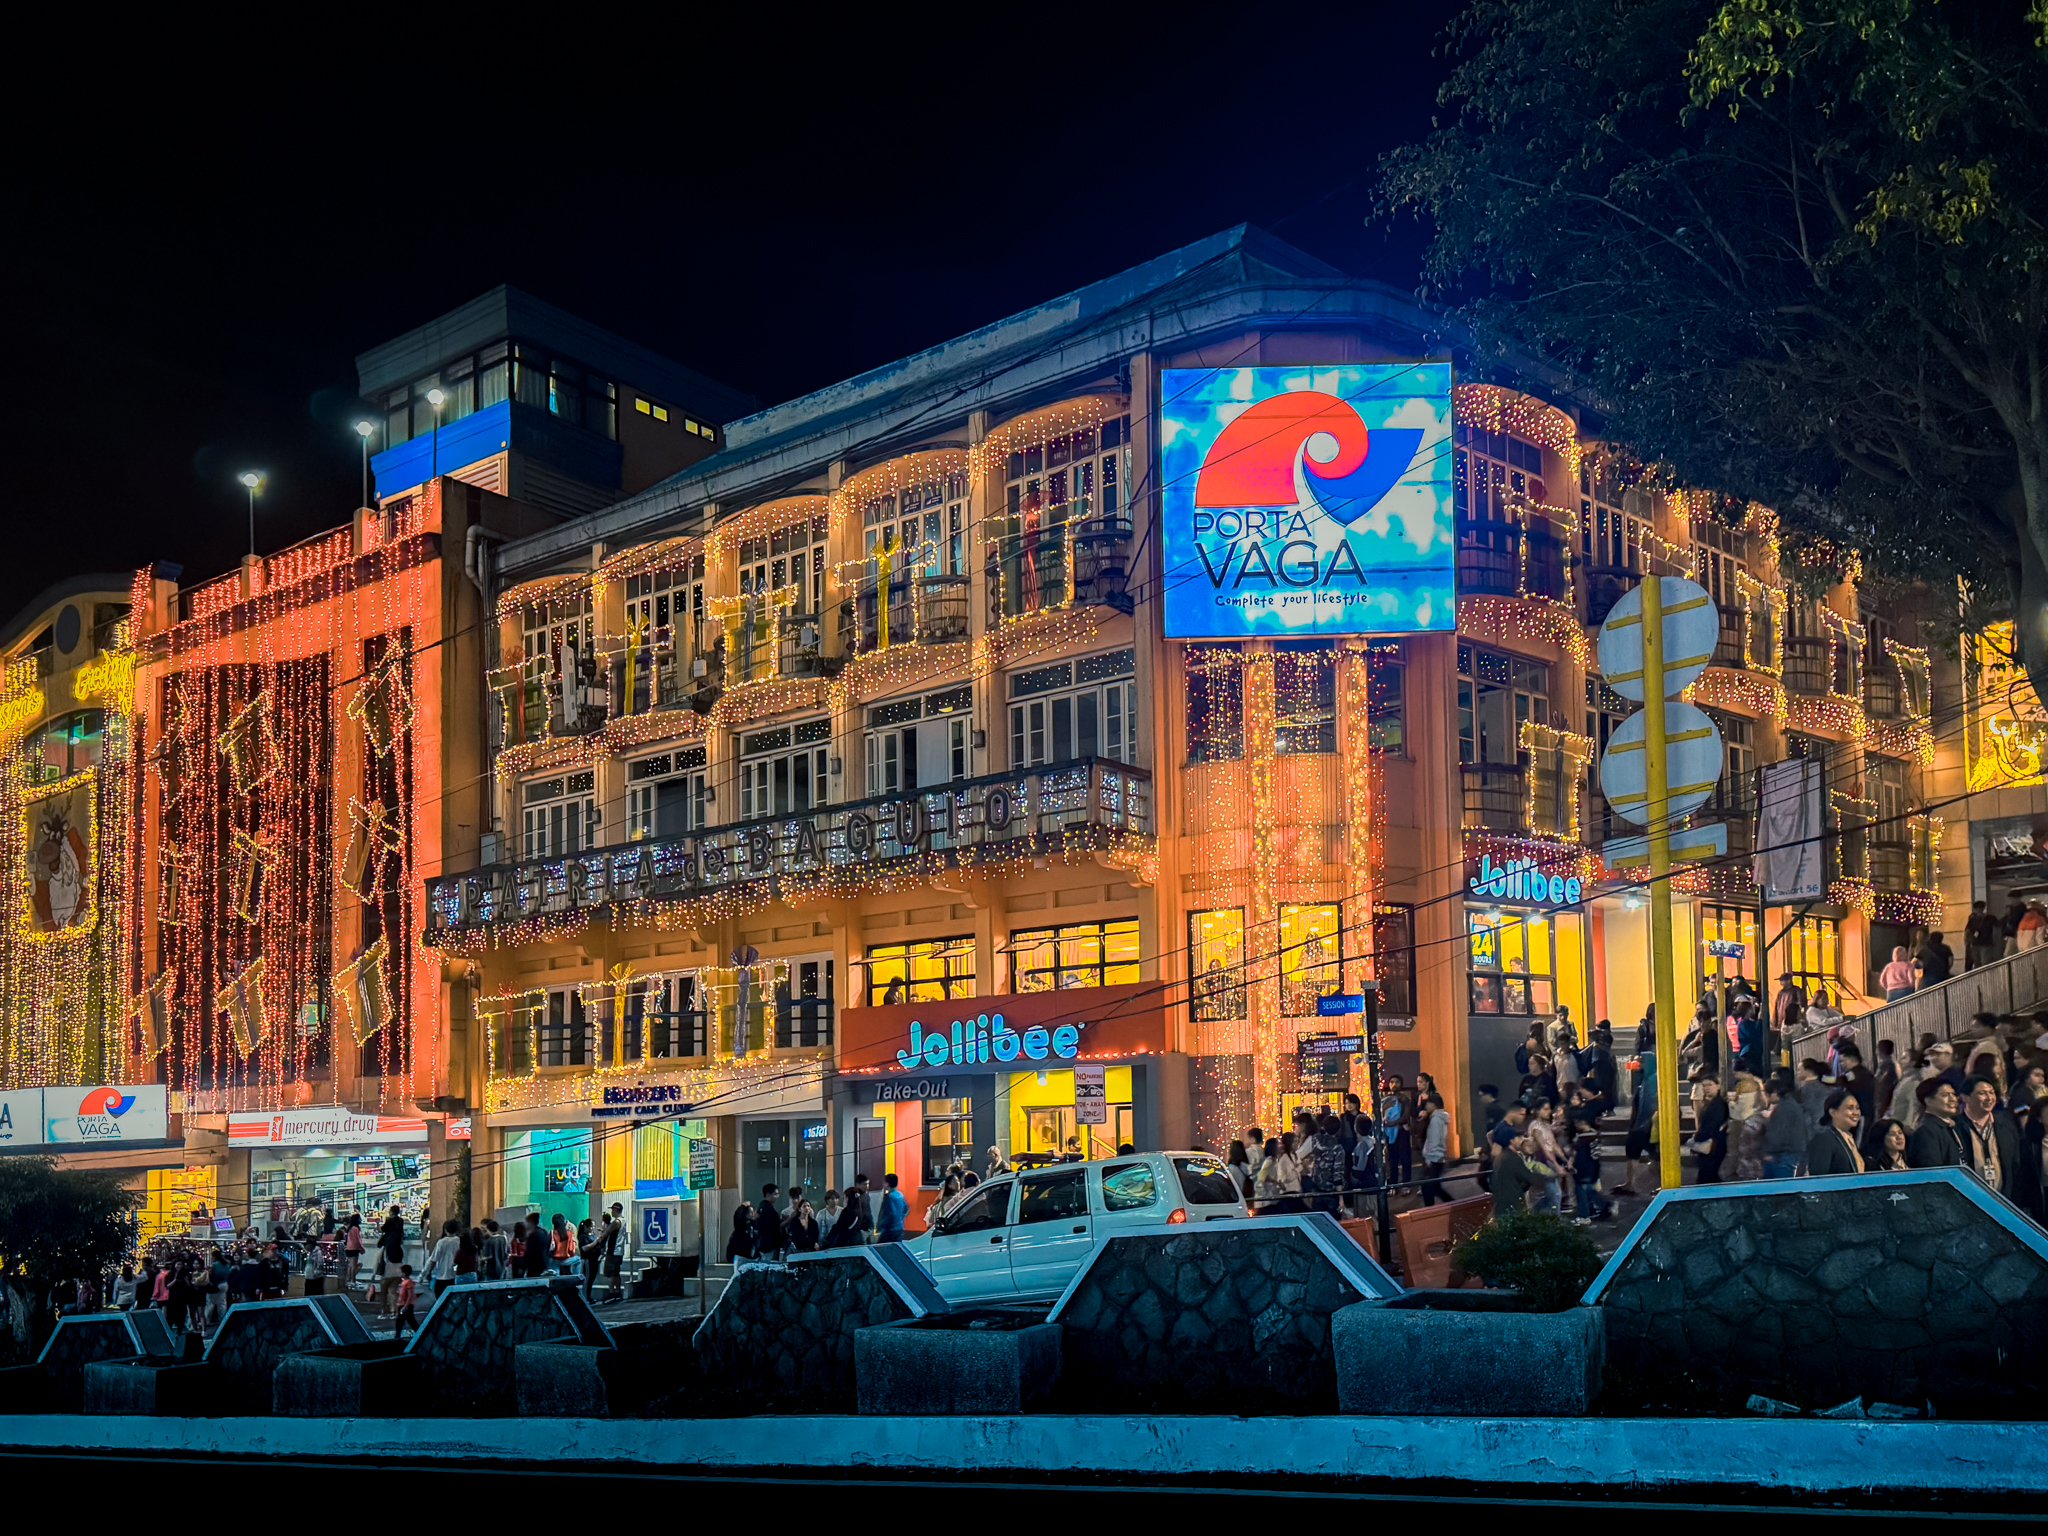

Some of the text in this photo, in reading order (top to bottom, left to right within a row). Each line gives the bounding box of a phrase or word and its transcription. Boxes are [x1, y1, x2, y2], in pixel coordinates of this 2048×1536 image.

[1193, 510, 1312, 541] PORTA
[1195, 539, 1367, 589] VAGA
[1215, 591, 1368, 608] Complete your lifestyle
[464, 788, 1013, 909] PATRIA de BAGUIO
[1470, 854, 1582, 904] Jollibee
[1471, 932, 1494, 957] 24
[1473, 955, 1492, 964] HOURS
[1322, 999, 1358, 1010] SESSION RD.
[896, 1013, 1080, 1069] Jollibee
[874, 1079, 949, 1100] Take-Out
[77, 1116, 107, 1124] PORTA
[77, 1122, 121, 1136] VAGA
[284, 1117, 374, 1136] mercury drug
[691, 1140, 698, 1151] 3
